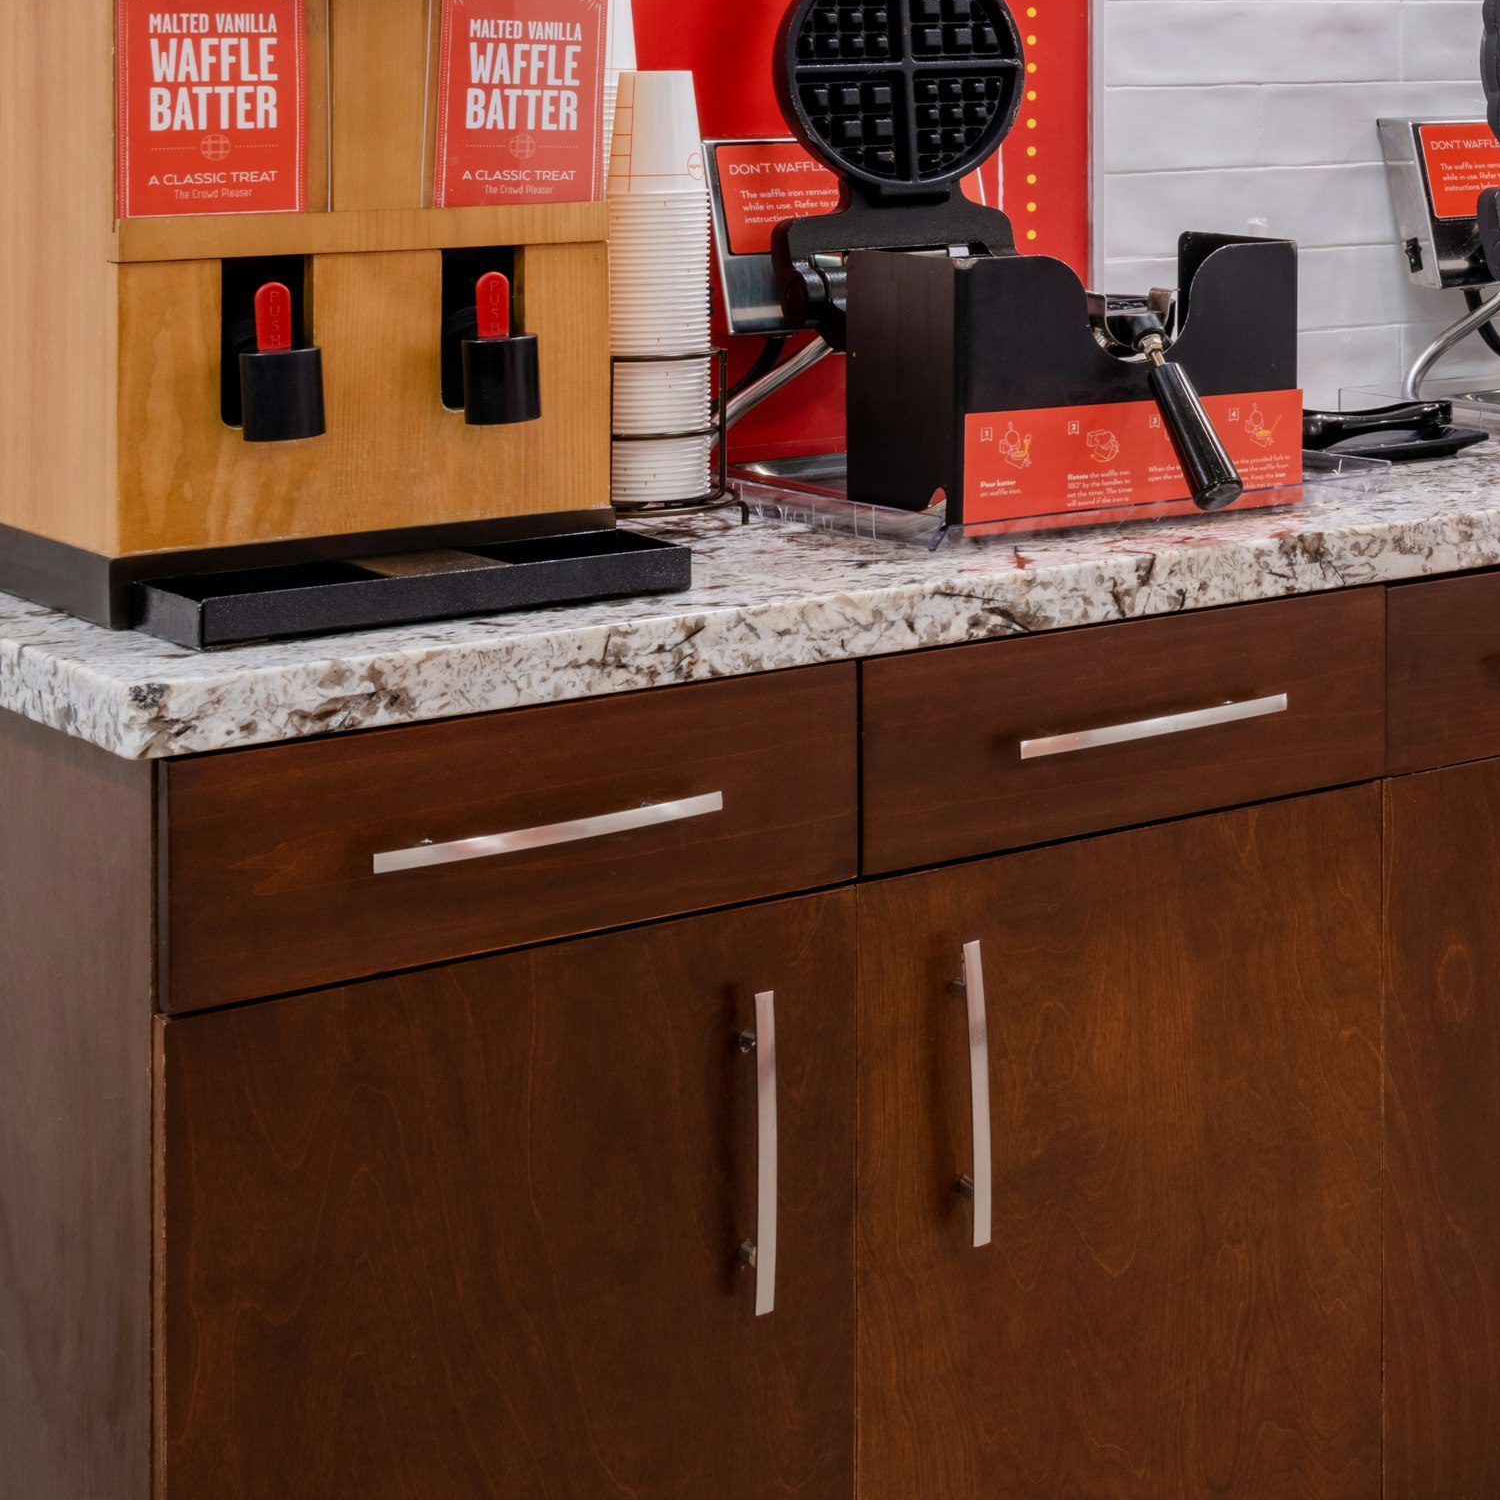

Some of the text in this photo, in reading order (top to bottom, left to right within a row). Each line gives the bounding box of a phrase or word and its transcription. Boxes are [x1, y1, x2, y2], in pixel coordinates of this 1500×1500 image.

[150, 13, 277, 33] MALTED VANILLA
[470, 19, 582, 41] MALTED VANILLA
[150, 38, 278, 82] WAFFLE
[470, 42, 581, 86] WAFFLE
[150, 86, 278, 131] BATTER
[466, 88, 577, 130] BATTER
[1431, 140, 1460, 150] DON'T
[729, 162, 771, 175] DON'T
[1454, 162, 1473, 170] waffle
[148, 171, 278, 185] A CLASSIC TREAT
[462, 170, 576, 180] A CLASSIC TREAT
[1480, 171, 1496, 179] Refer
[175, 188, 253, 200] The Crowd Pleaser
[485, 185, 554, 194] The Crowd Pleaser
[741, 190, 758, 198] The
[759, 188, 786, 198] waffle
[806, 187, 838, 196] remains
[743, 202, 764, 211] while
[766, 202, 774, 210] in
[776, 202, 793, 210] use.
[794, 199, 818, 208] Refer
[489, 280, 500, 334] PUSH
[270, 290, 281, 347] PUSH
